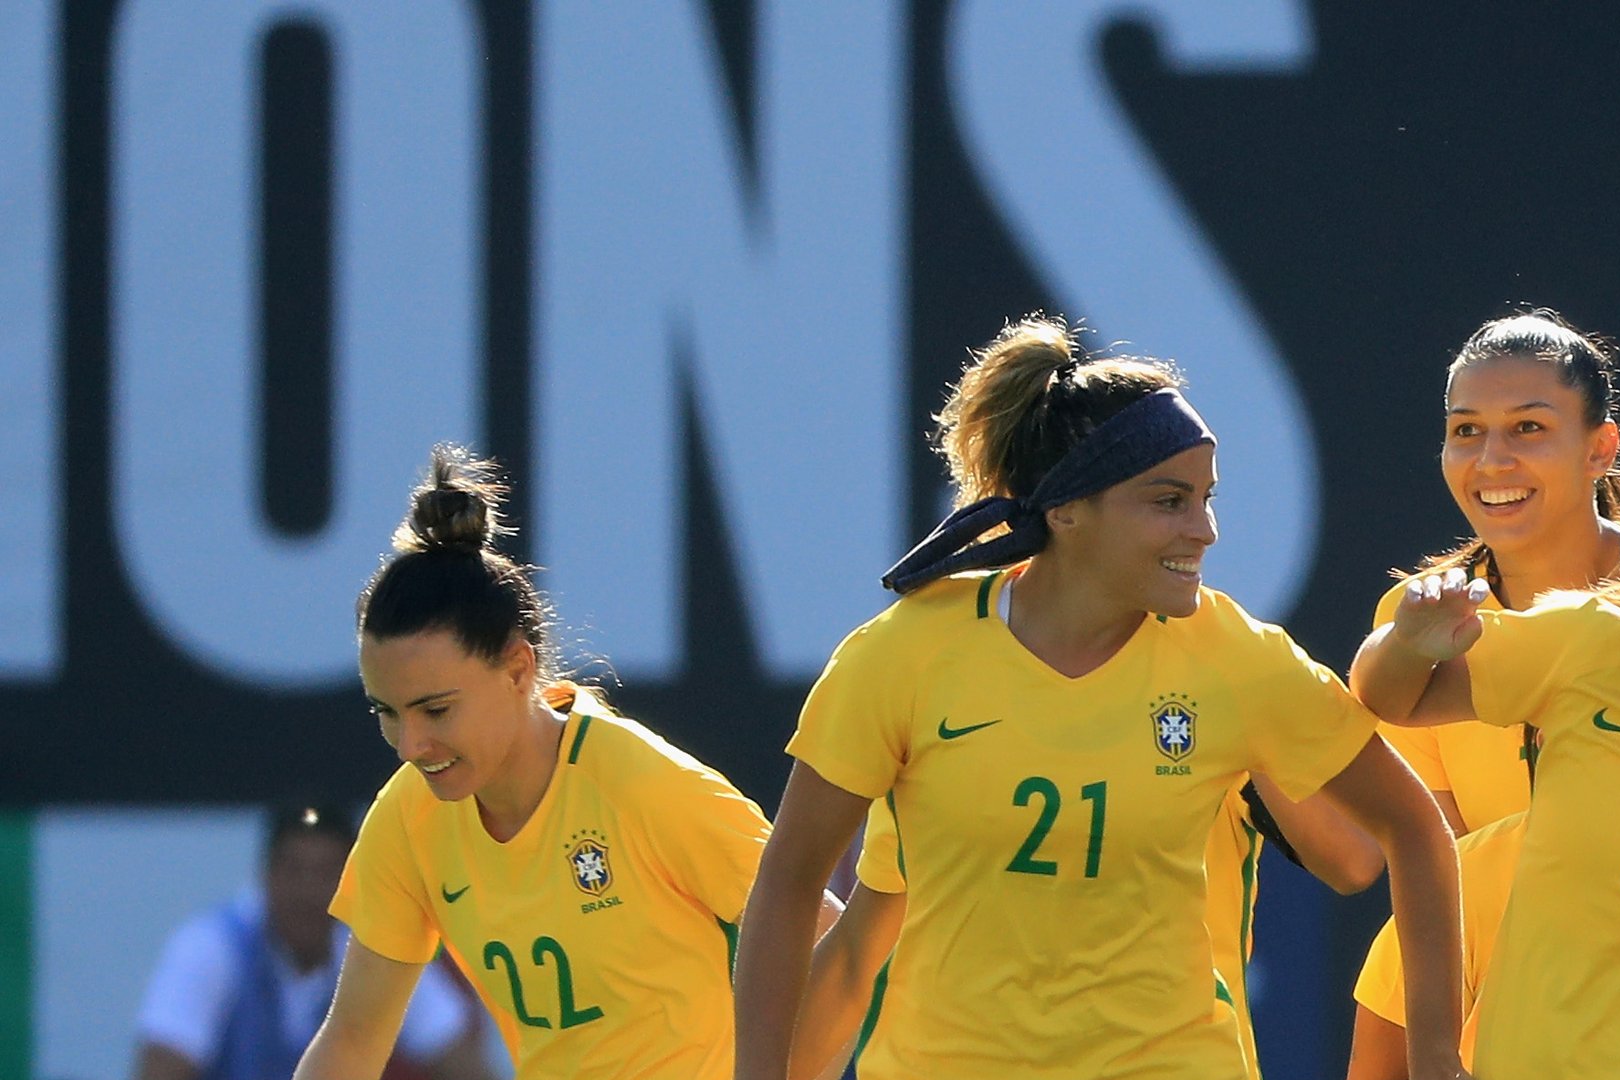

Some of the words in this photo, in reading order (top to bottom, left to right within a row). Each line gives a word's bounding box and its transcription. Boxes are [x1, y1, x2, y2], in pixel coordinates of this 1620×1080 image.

[1155, 765, 1192, 776] BRASIL
[1006, 776, 1108, 878] 21
[580, 895, 624, 914] BRASIL
[483, 934, 604, 1030] 22
